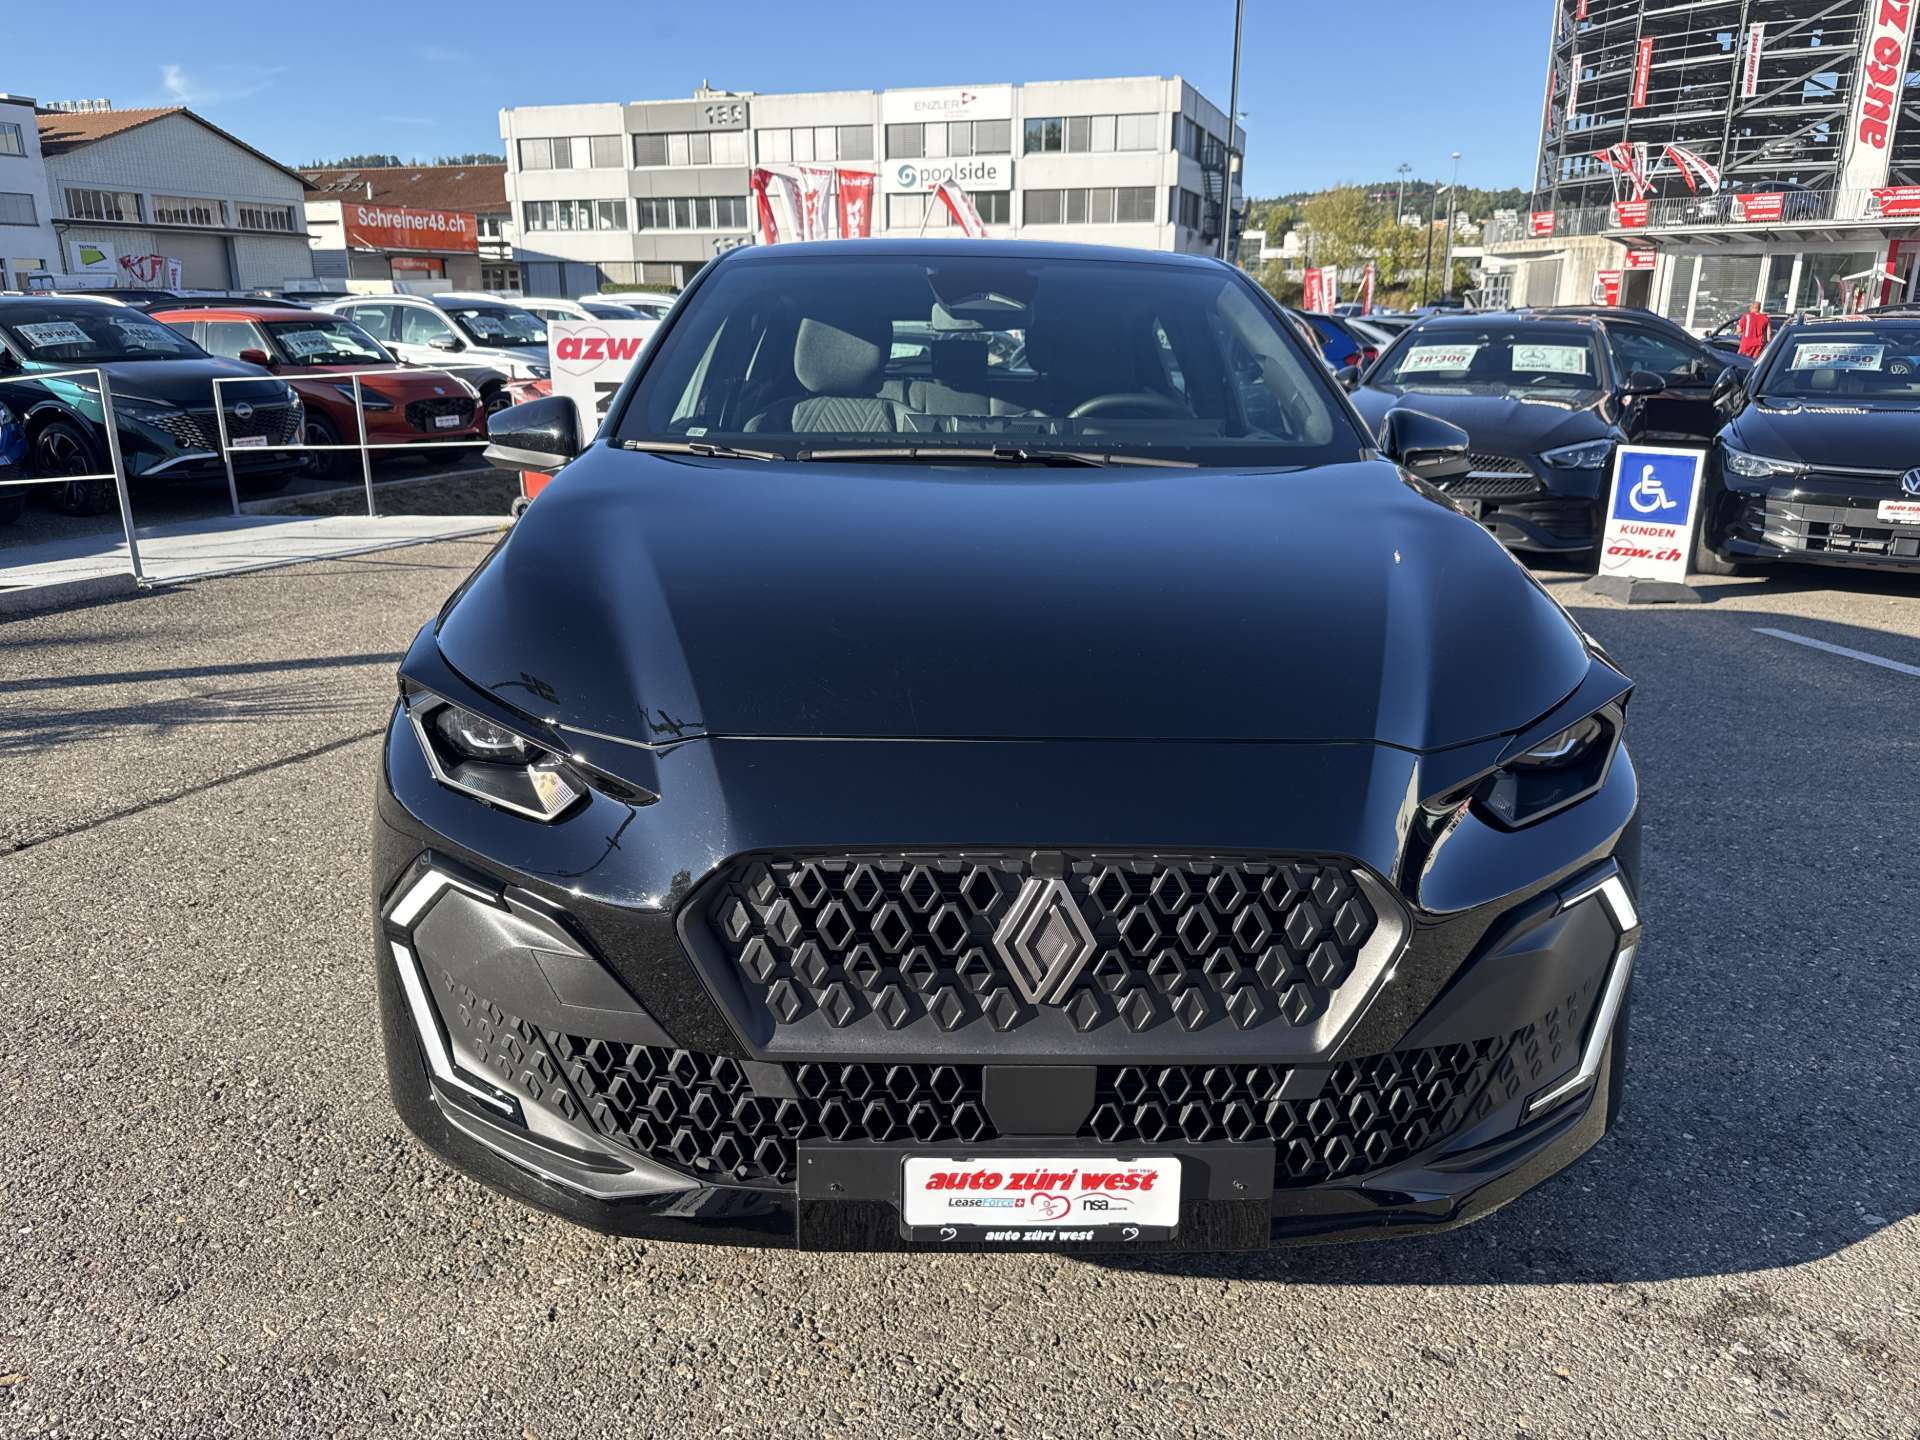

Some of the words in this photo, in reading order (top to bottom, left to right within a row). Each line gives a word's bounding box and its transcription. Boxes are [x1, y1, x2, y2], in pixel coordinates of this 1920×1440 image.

[1860, 36, 1901, 149] auto
[914, 99, 960, 111] ENZLER
[920, 161, 997, 188] poolside
[357, 208, 466, 232] Schreiner48.ch
[557, 338, 643, 360] azw
[1620, 525, 1676, 538] KUNDEN
[1607, 546, 1681, 562] azw.ch
[925, 1169, 1003, 1190] auto
[1004, 1168, 1078, 1190] züri
[1081, 1171, 1158, 1191] west
[948, 1198, 1014, 1208] LeaseForce
[1083, 1200, 1109, 1211] nsa
[985, 1231, 1020, 1241] auto
[1022, 1230, 1056, 1241] züri
[1059, 1230, 1094, 1241] west
